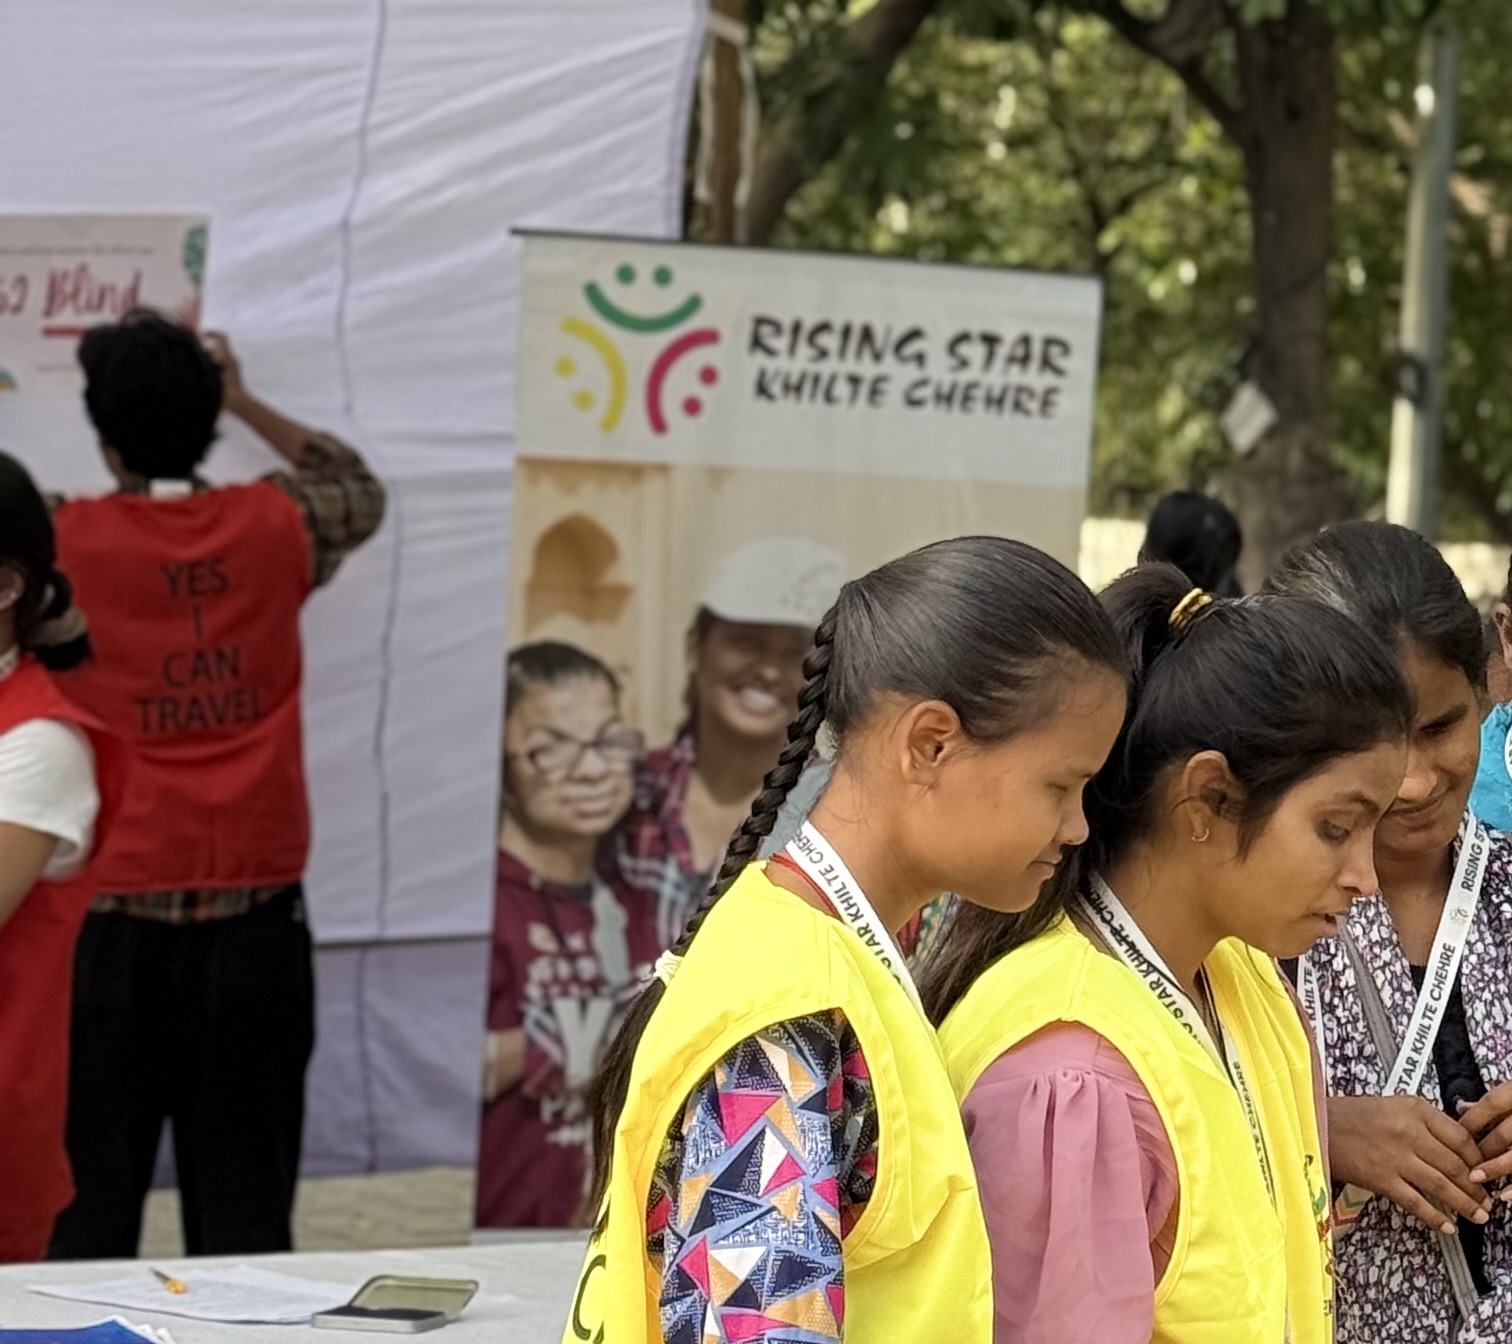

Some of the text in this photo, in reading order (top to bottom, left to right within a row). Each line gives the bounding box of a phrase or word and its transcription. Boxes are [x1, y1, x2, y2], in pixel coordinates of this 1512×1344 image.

[750, 314, 1072, 377] RISING STAR
[753, 366, 1060, 419] KHILTE CHEHRE
[160, 558, 229, 597] YES
[191, 604, 204, 641] I
[162, 645, 241, 688] CAN
[133, 686, 262, 735] TRAVEL
[1461, 842, 1484, 893] RISING
[817, 862, 865, 924] KHILTE
[1148, 975, 1185, 1021] STAR
[1410, 1001, 1439, 1056] KHILTE
[1430, 943, 1456, 1003] CHEHRE
